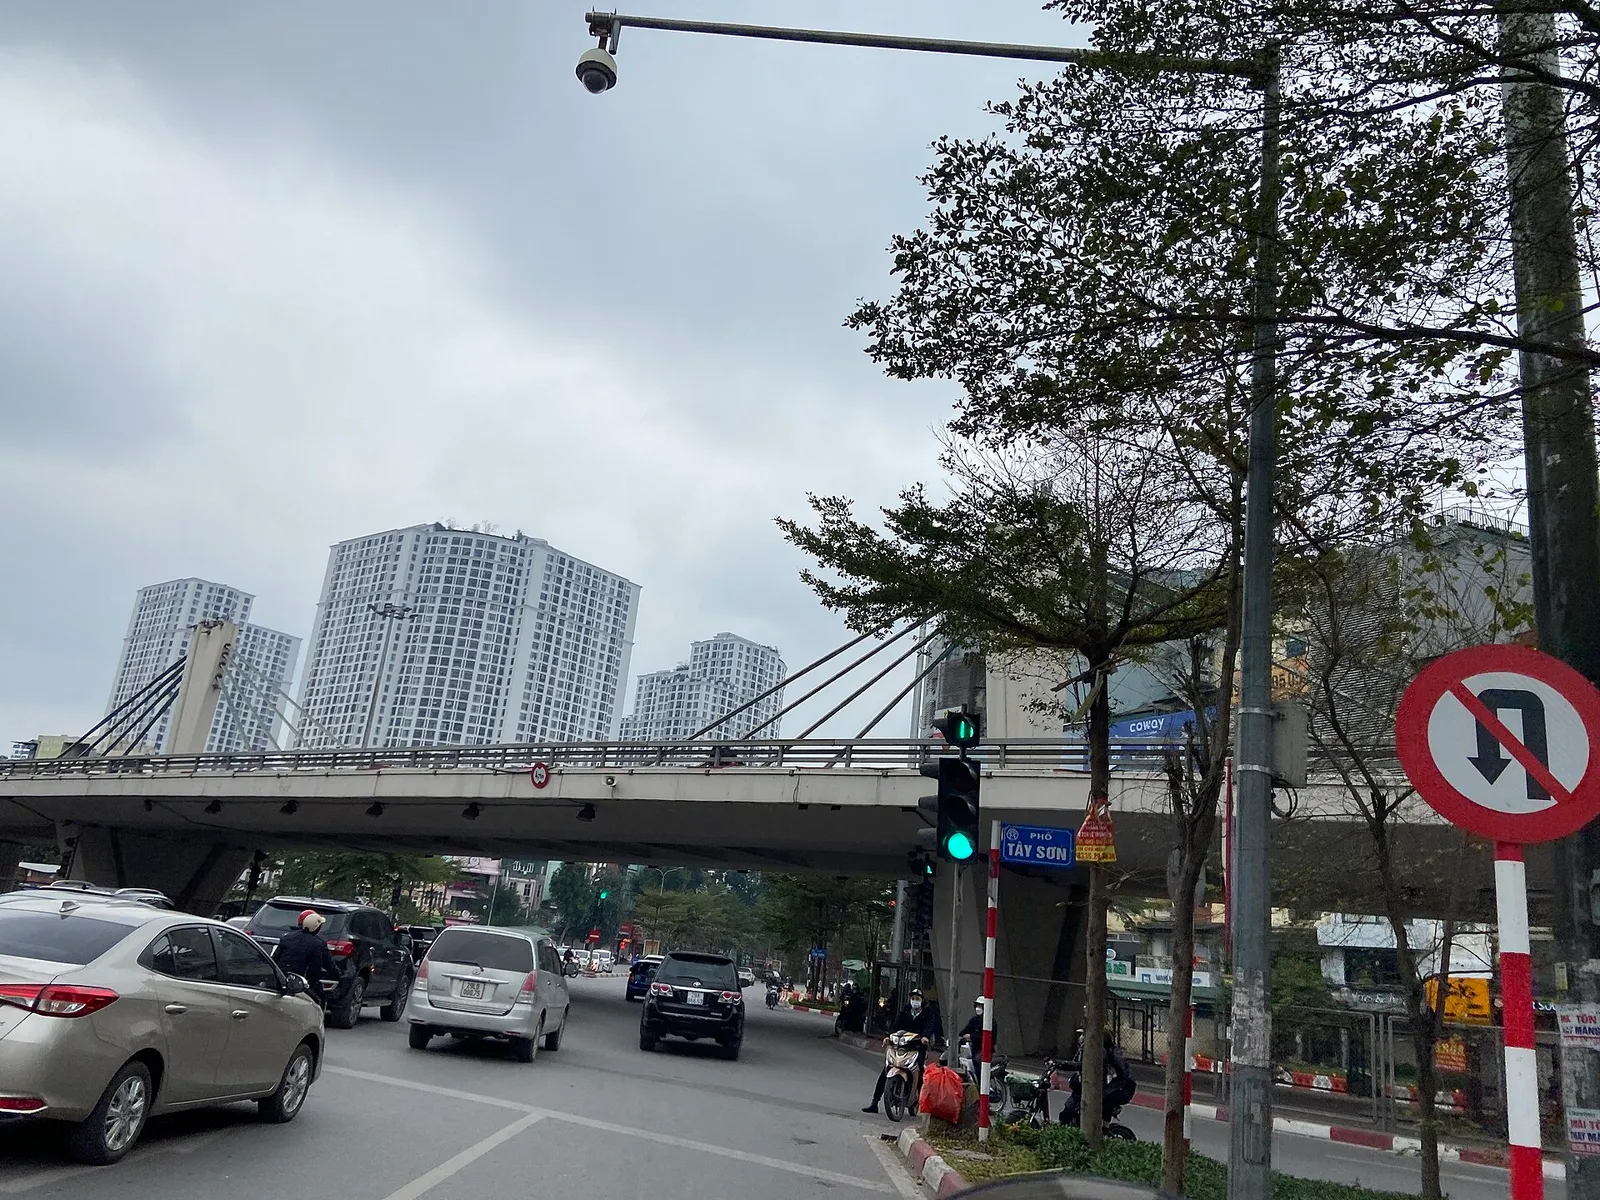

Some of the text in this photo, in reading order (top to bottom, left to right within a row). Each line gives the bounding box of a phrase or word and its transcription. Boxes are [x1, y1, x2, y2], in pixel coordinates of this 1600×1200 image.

[1030, 830, 1053, 841] PHỐ
[1007, 841, 1067, 861] TÂY SƠN
